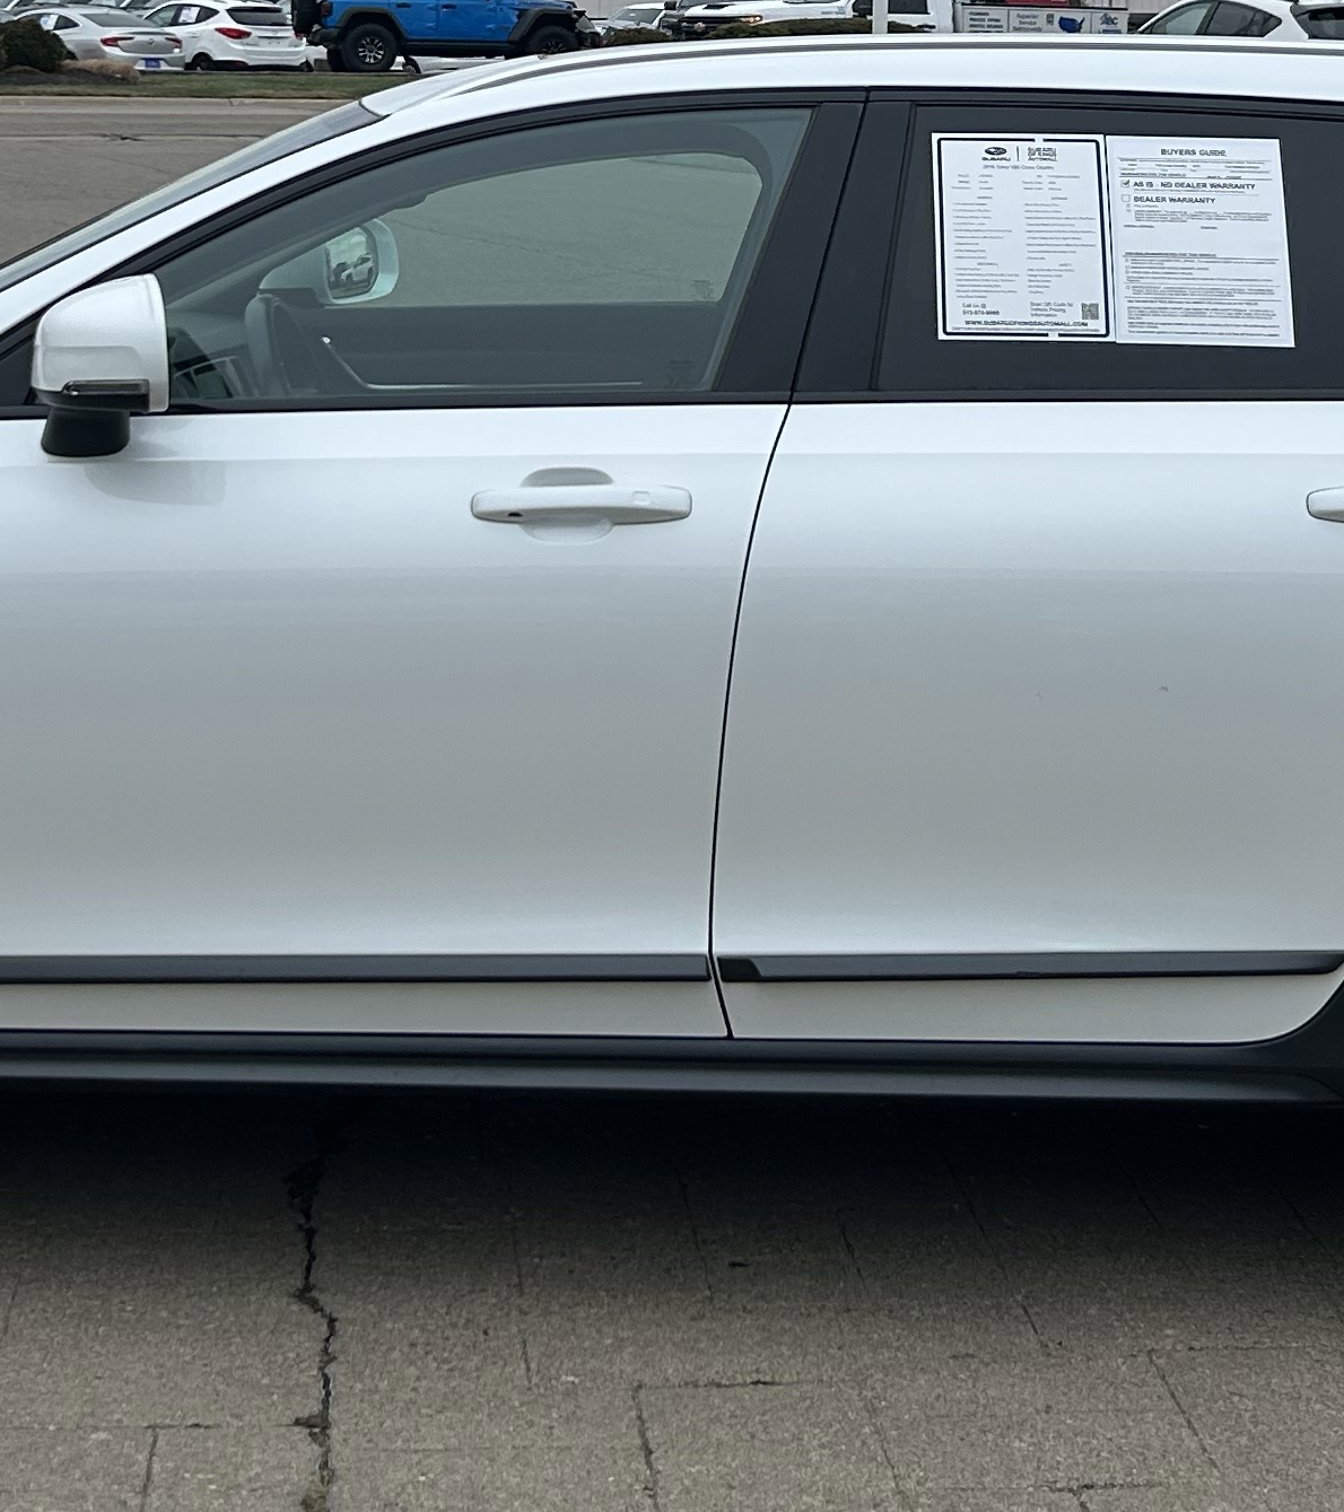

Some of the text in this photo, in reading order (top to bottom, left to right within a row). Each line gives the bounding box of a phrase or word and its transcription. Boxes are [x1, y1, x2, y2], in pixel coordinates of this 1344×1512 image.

[1160, 148, 1227, 157] BUYERS GUIDE
[1209, 182, 1256, 190] WARRANTY
[1168, 196, 1216, 204] WARRANTY
